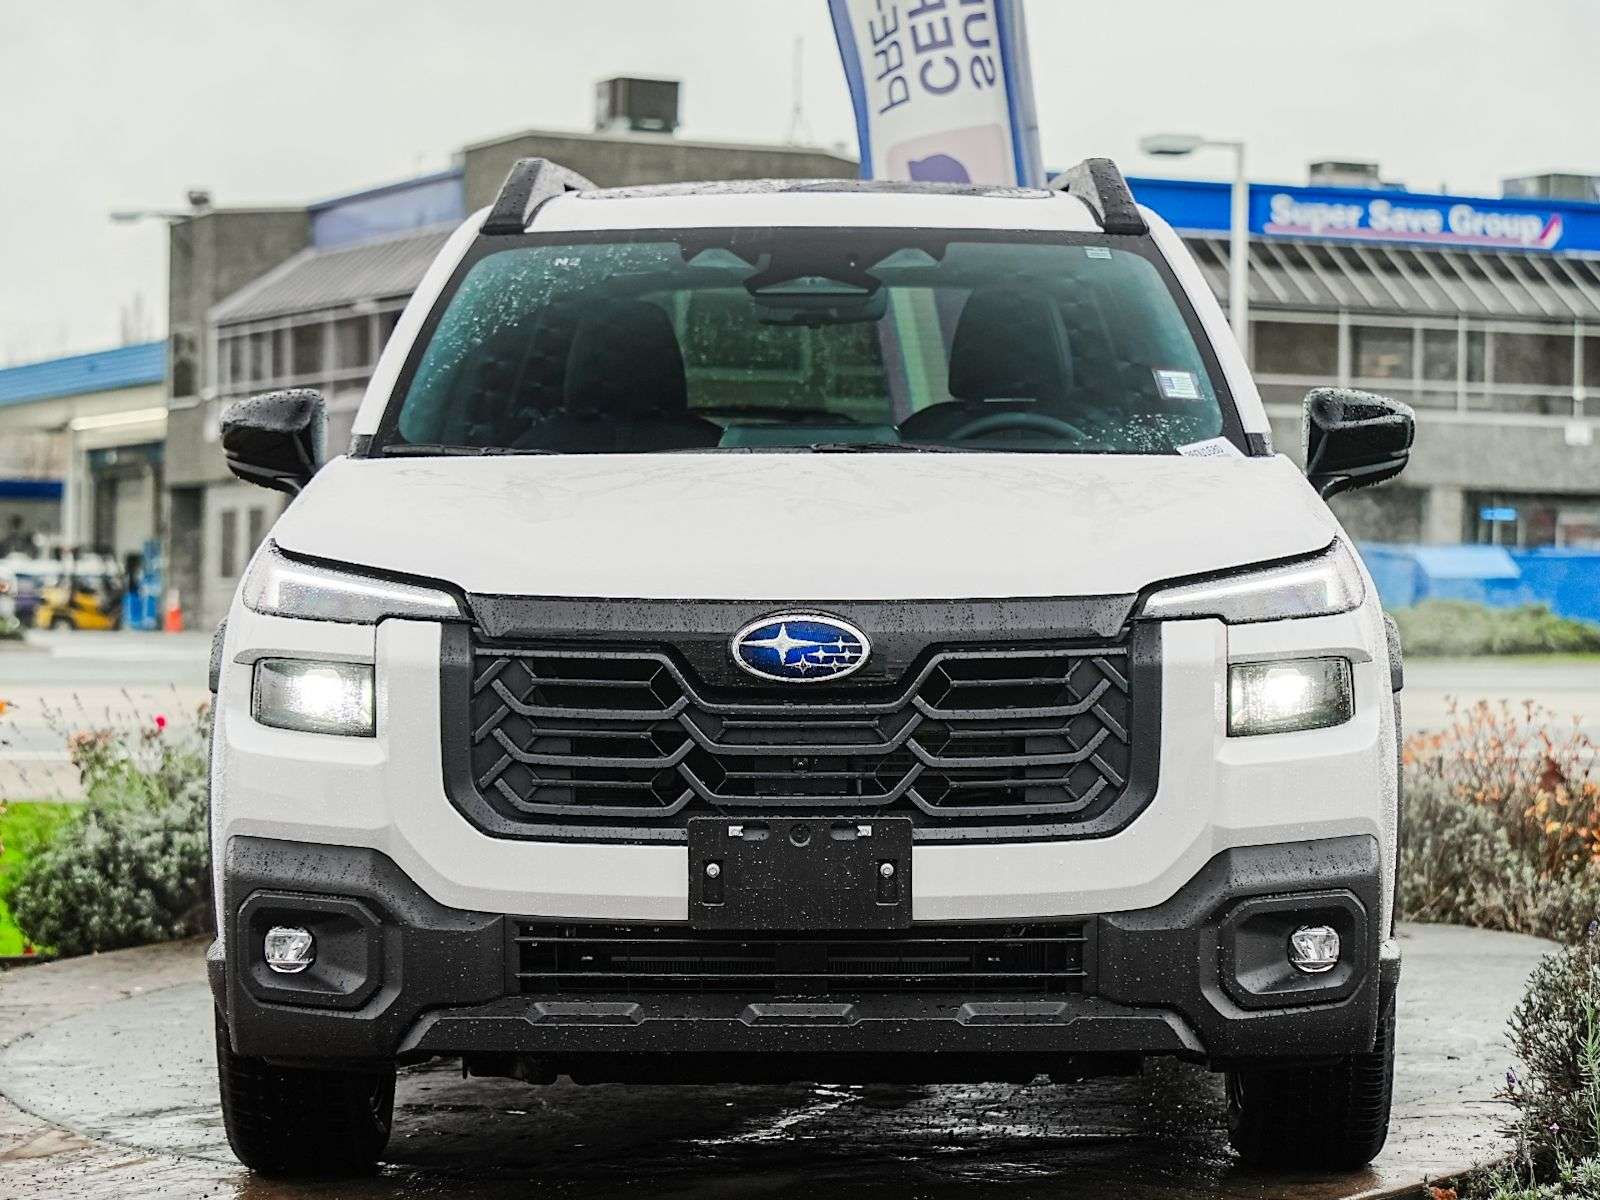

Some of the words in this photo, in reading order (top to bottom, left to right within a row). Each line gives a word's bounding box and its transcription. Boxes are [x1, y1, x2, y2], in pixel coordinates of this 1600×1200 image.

[1269, 193, 1364, 235] Super
[1368, 198, 1444, 234] Save
[1449, 203, 1544, 246] Group
